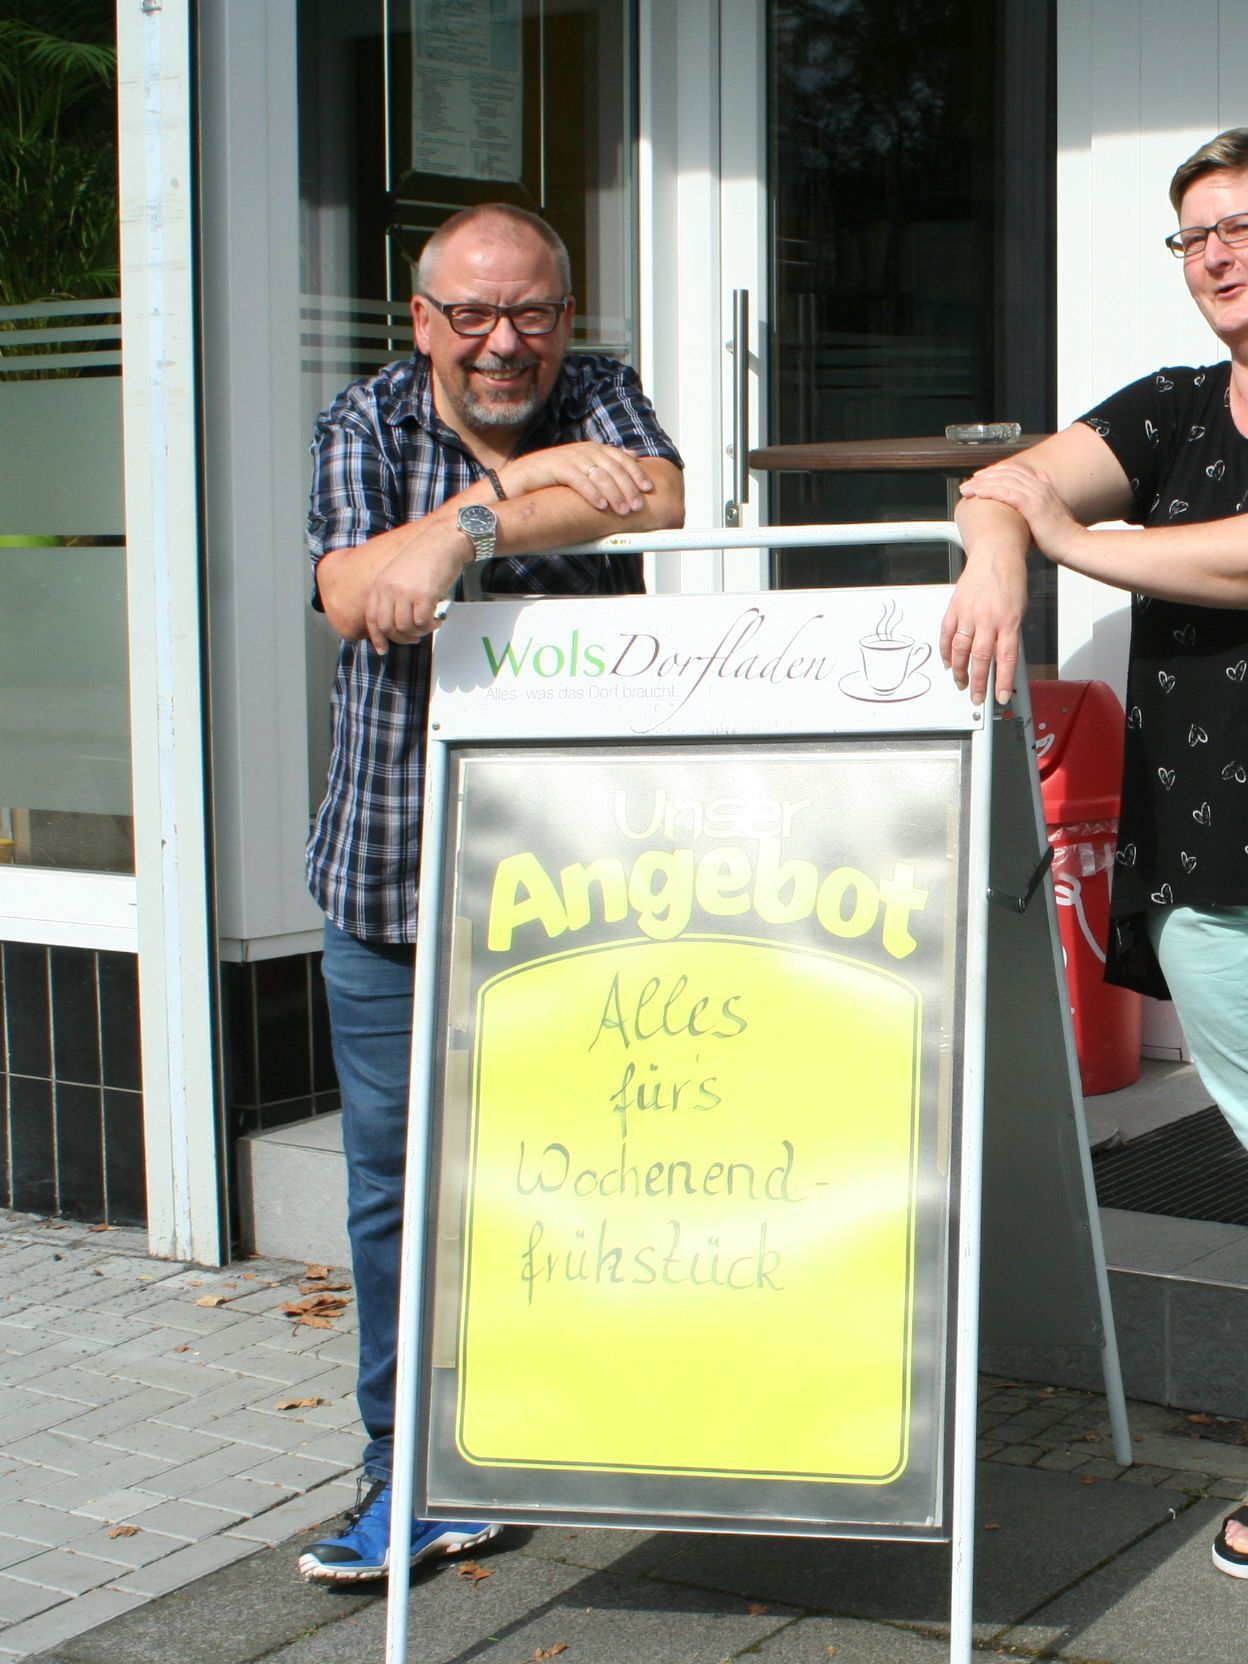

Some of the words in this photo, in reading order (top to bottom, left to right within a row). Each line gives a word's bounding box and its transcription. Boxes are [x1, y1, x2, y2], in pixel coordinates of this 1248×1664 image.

[526, 688, 555, 700] was
[558, 686, 586, 700] das
[589, 684, 620, 699] Dorf
[613, 789, 812, 840] Unser
[488, 838, 930, 959] Angebot
[588, 970, 748, 1052] Alles
[609, 1055, 723, 1138] für's
[520, 1217, 785, 1307] frühstück
